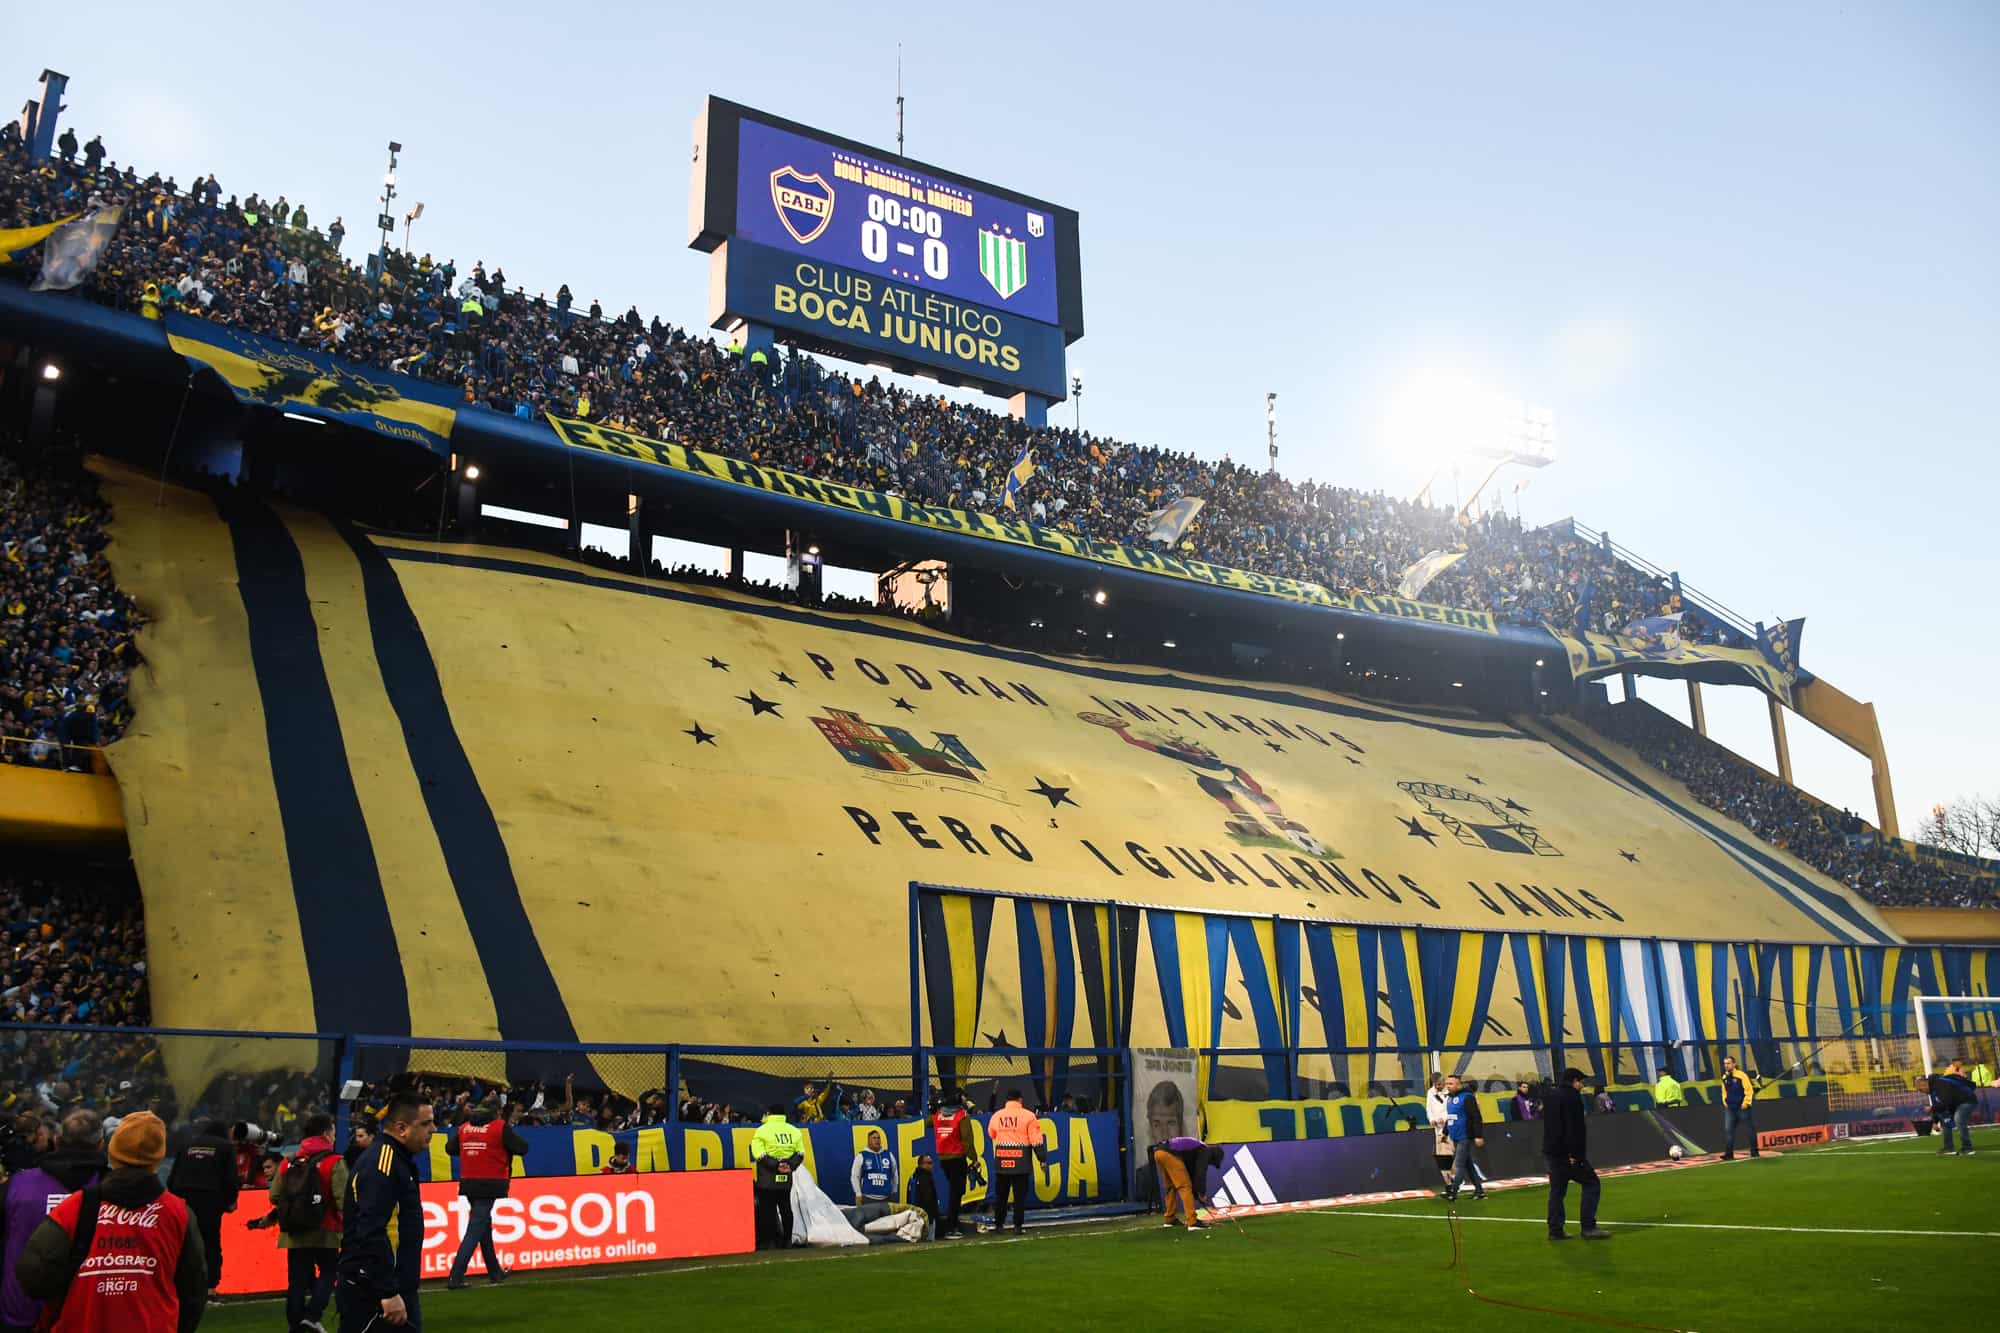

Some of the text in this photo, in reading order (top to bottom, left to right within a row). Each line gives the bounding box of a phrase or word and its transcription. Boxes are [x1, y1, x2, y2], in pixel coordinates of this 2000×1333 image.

[781, 191, 825, 213] CABJ
[867, 193, 943, 239] 00:00
[861, 220, 888, 263] 0
[922, 237, 949, 281] 0
[773, 283, 1021, 372] BOCA JUNIORS
[795, 262, 1003, 338] CLUB ATLÉTICO
[561, 422, 715, 476] ESTA
[723, 458, 997, 536] HINCHADA
[804, 649, 1366, 754] PODRAN IMITARNOS
[842, 805, 1625, 922] PERO IGUALARNOS JAMAS
[422, 1189, 657, 1250] etsson
[425, 1250, 486, 1272] LEAL
[519, 1243, 601, 1267] apuestas
[605, 1239, 657, 1257] online
